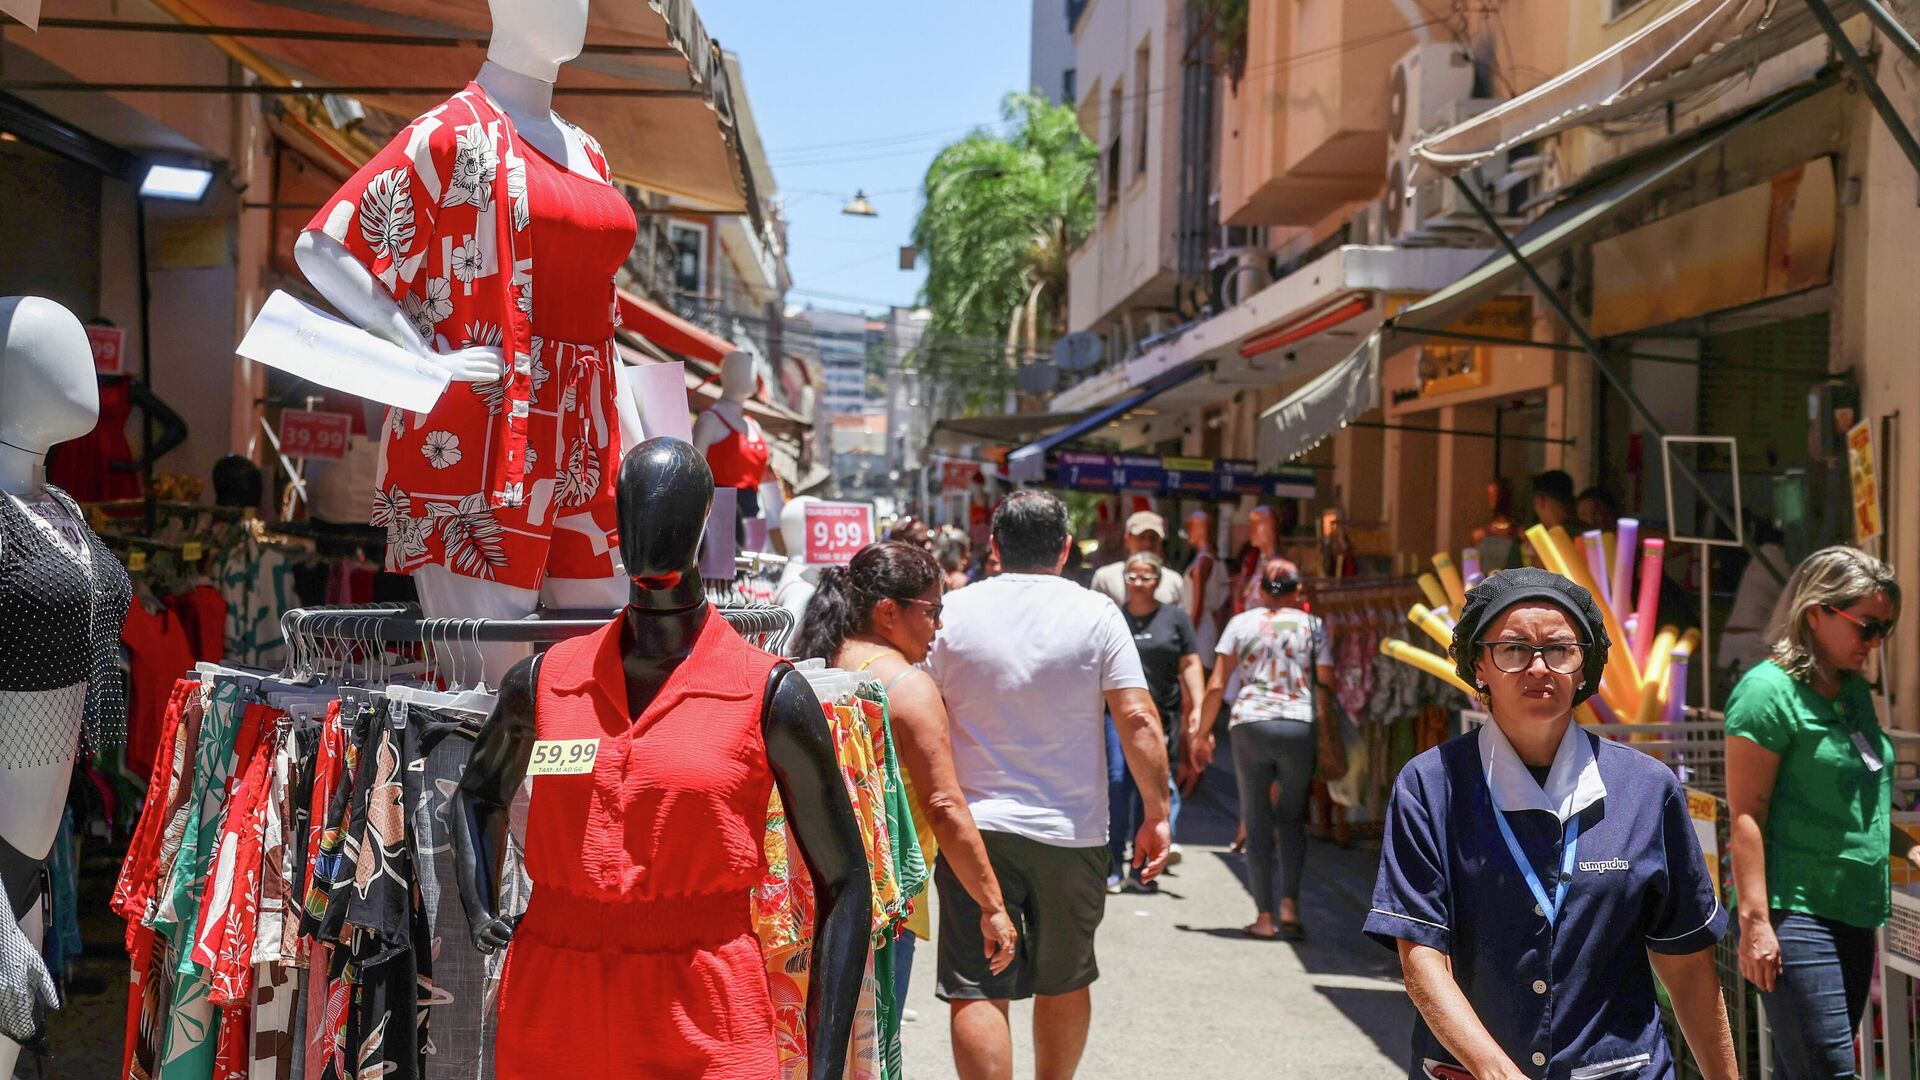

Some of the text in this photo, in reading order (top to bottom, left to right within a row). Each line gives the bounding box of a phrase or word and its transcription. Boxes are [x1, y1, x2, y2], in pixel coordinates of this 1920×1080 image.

[285, 427, 343, 450] 39,99
[813, 522, 862, 550] 9,99
[533, 743, 596, 766] 59,99
